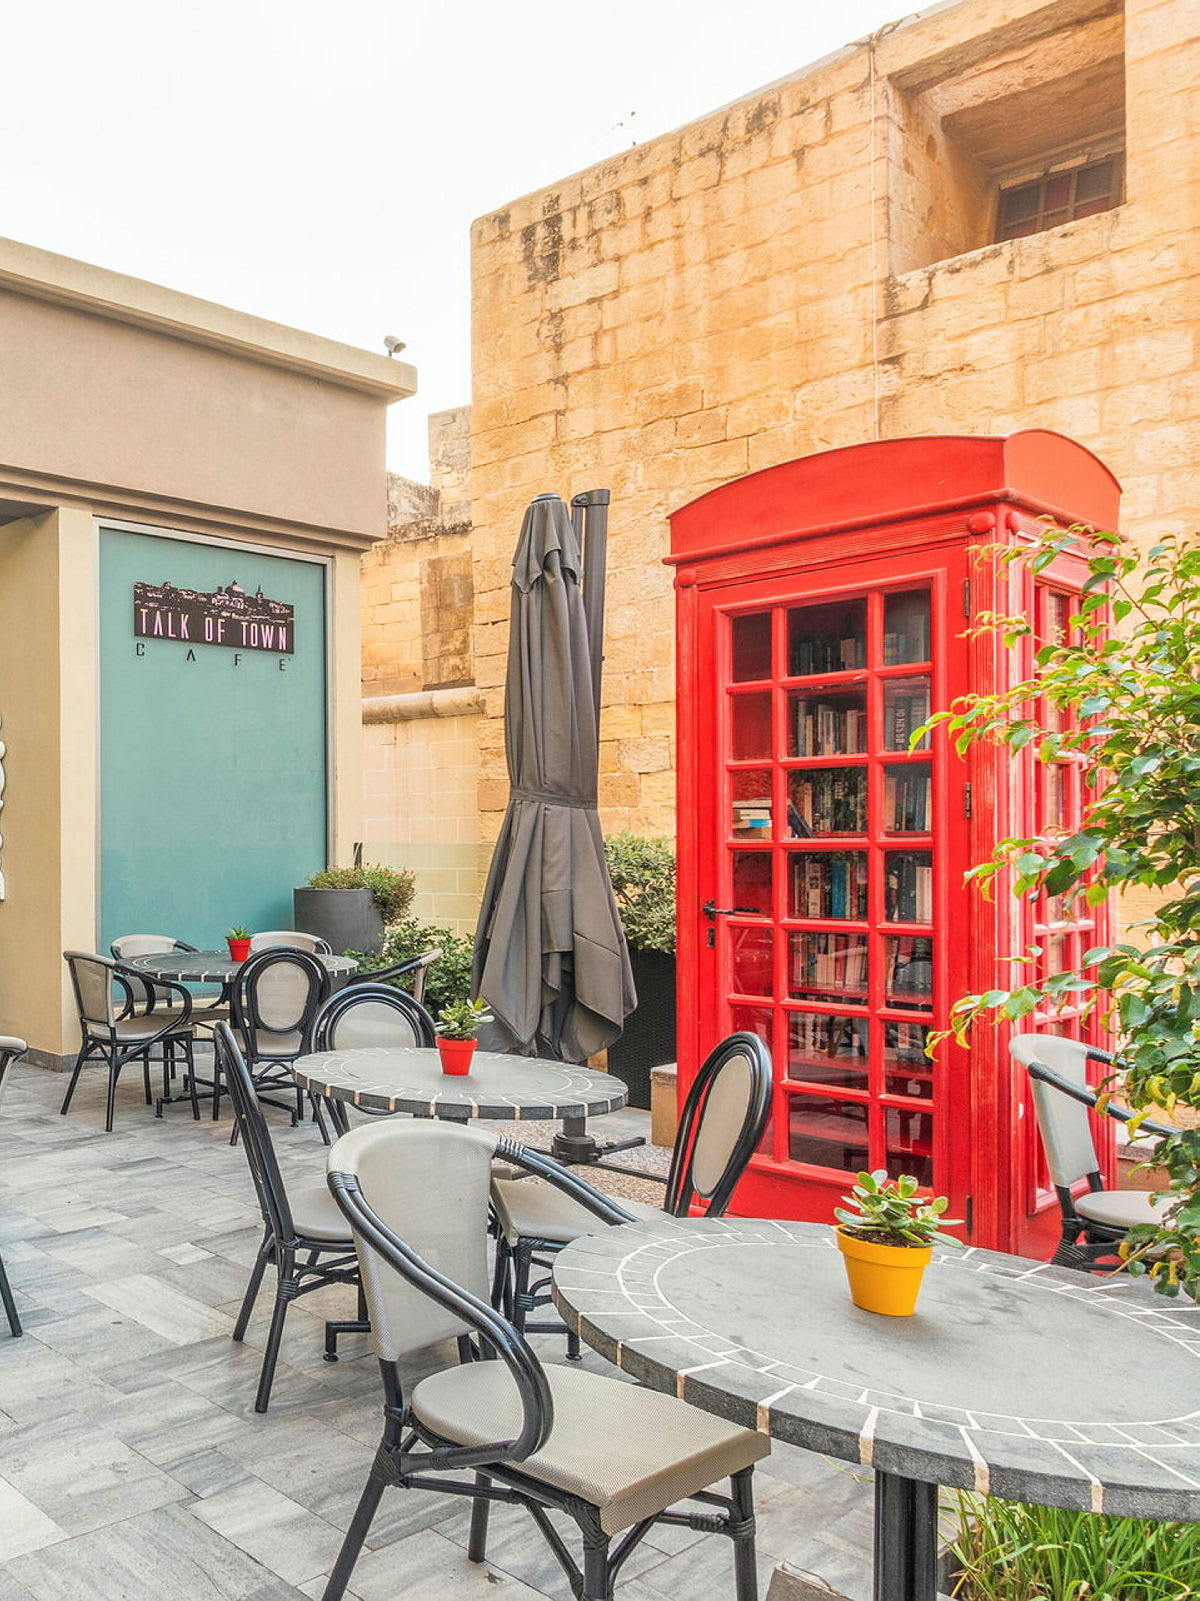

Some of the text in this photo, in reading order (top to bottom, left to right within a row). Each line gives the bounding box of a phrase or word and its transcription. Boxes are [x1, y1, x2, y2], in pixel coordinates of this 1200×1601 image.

[140, 608, 288, 651] TALK OF TOWN
